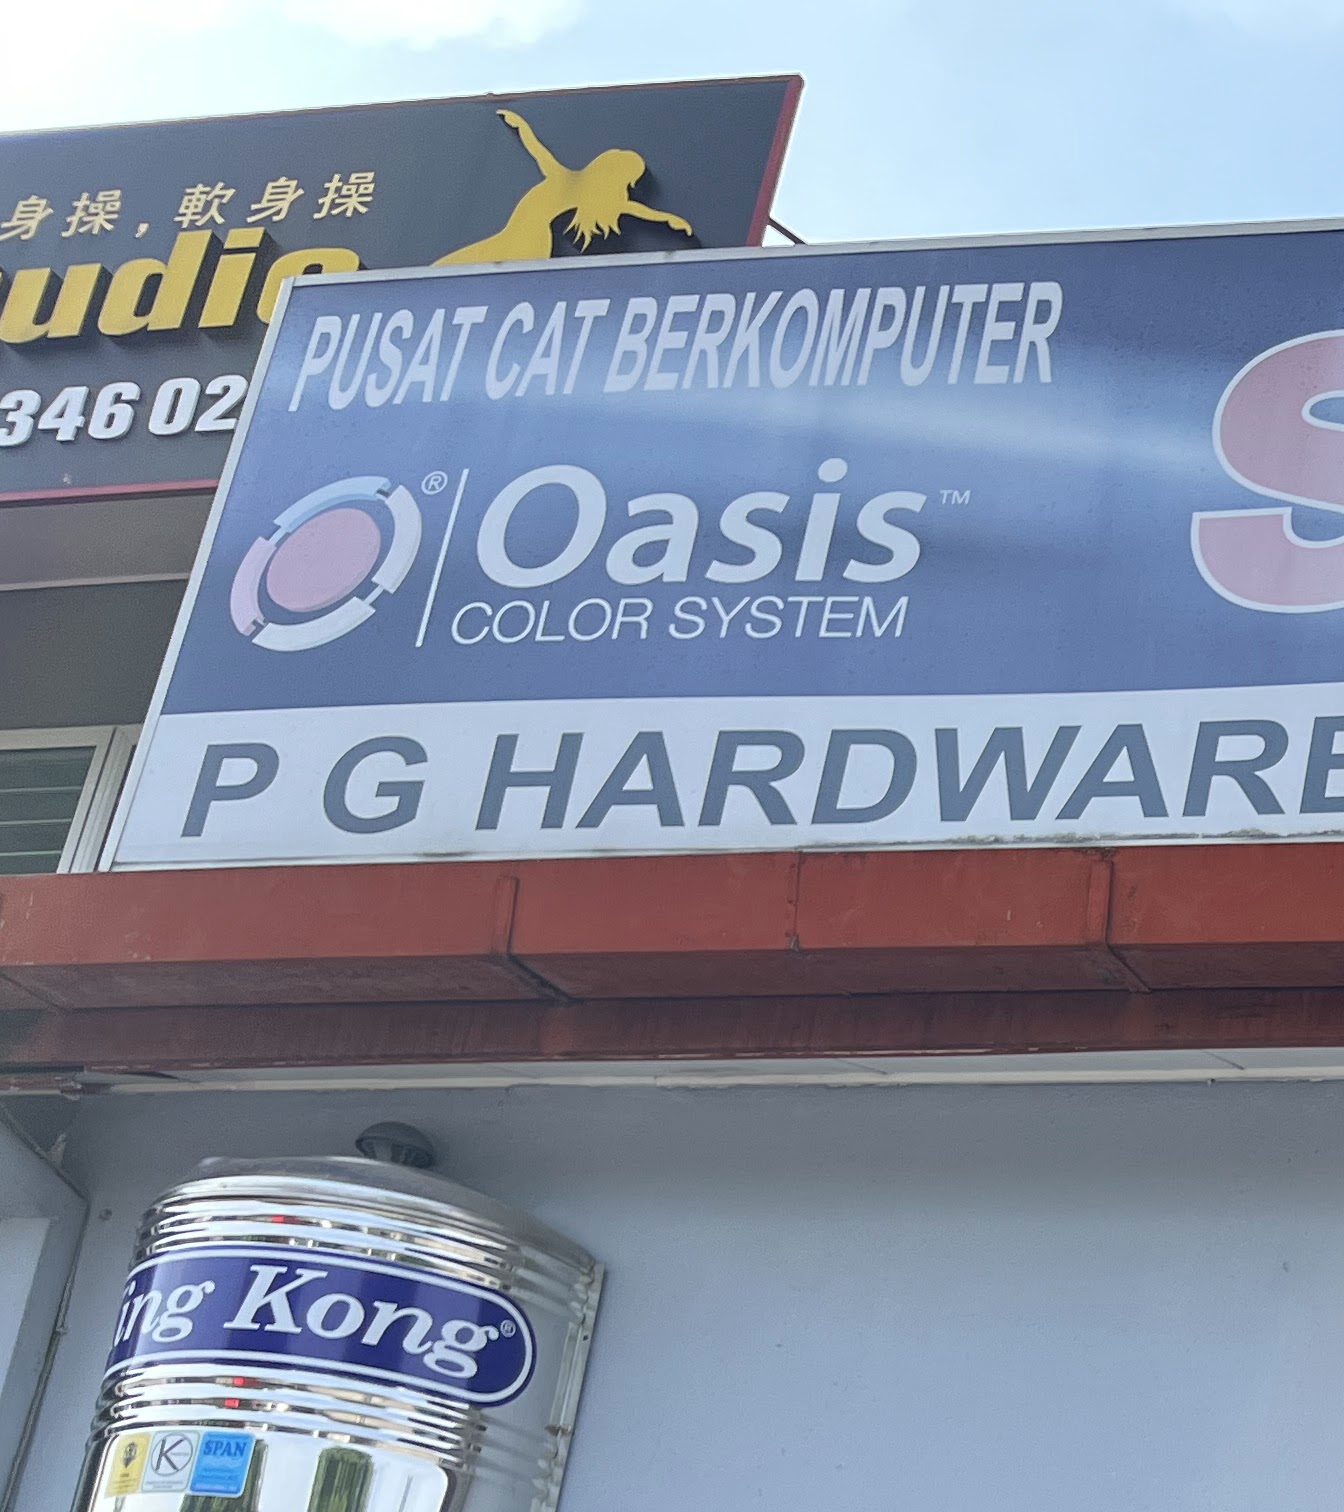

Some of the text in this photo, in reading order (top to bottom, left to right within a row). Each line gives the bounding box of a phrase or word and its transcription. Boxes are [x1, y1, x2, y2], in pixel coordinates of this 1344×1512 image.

[288, 280, 1063, 413] PUSAT CAT BERKOMPUTER
[476, 457, 929, 589] Oasis
[450, 595, 910, 646] COLOR SYSTEM
[181, 742, 280, 839] P
[321, 735, 429, 835] G
[222, 1263, 500, 1380] Kong
[203, 1439, 249, 1460] SPAN
